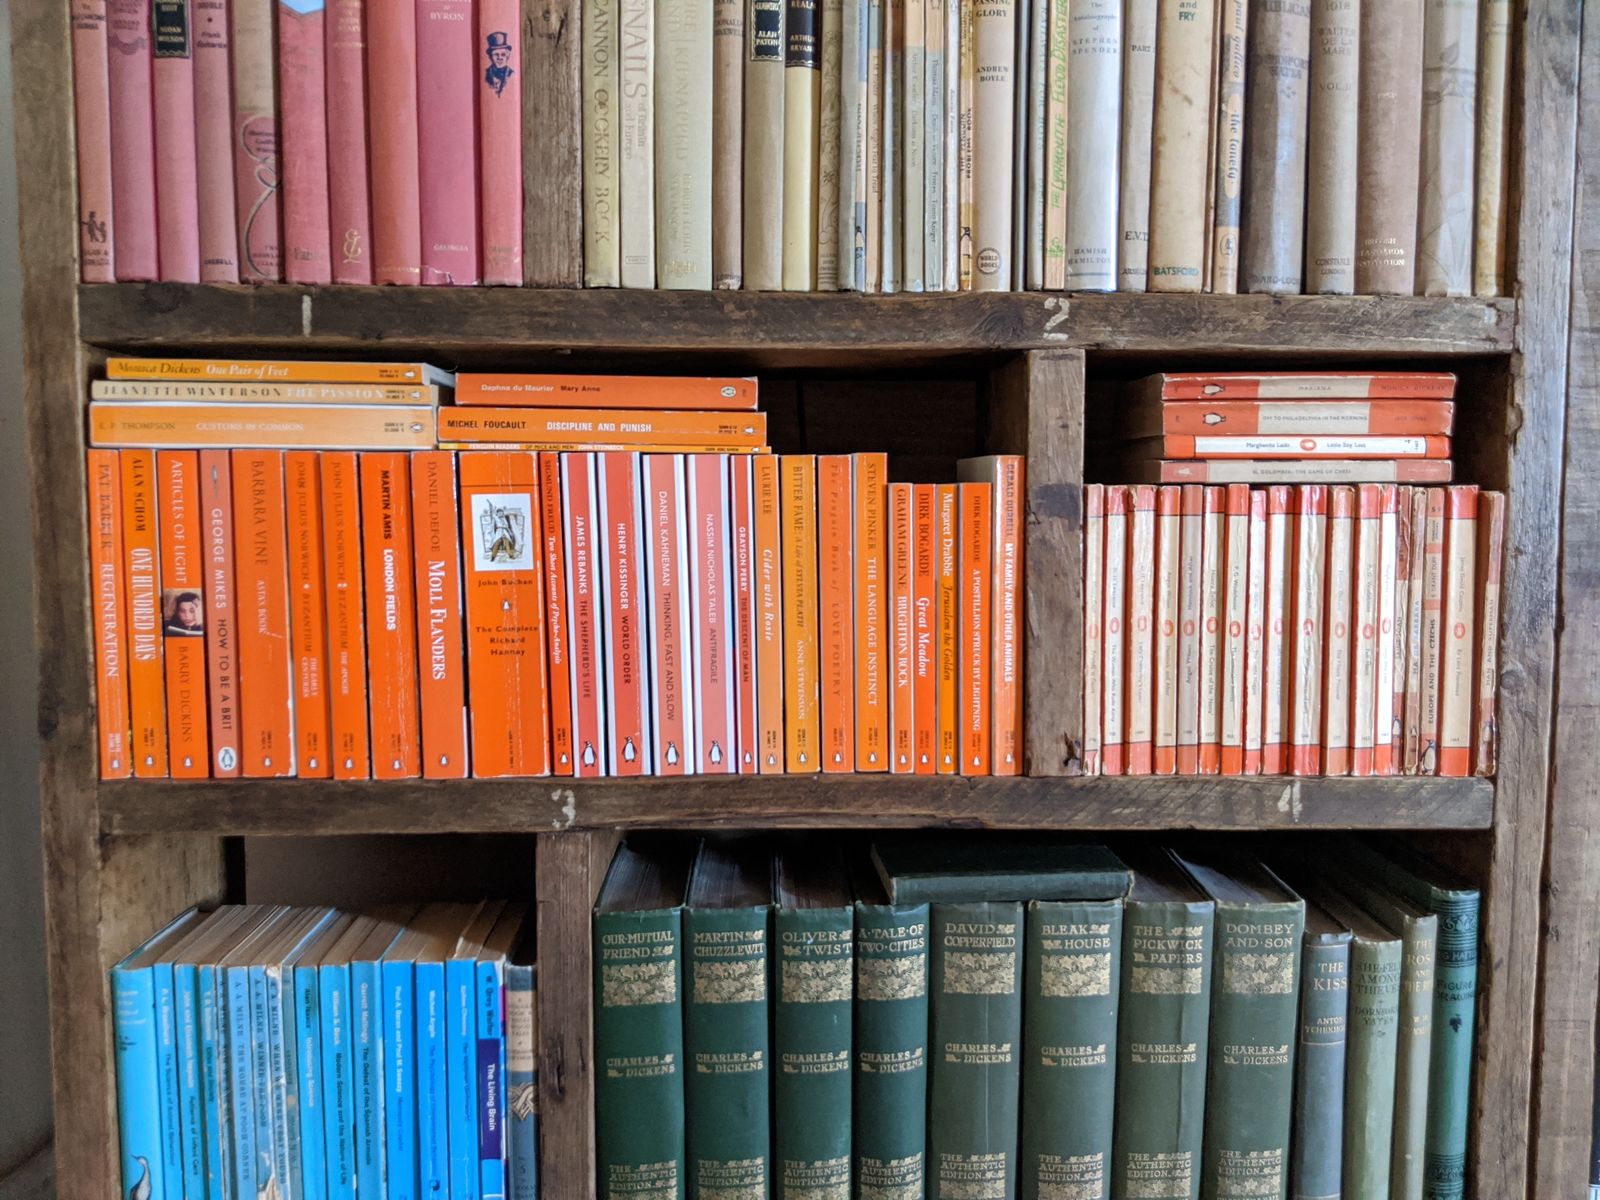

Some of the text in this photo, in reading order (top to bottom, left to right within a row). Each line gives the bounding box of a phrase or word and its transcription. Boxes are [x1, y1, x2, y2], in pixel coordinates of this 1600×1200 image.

[430, 11, 465, 22] BYRON
[976, 9, 1008, 18] GLORY
[1179, 12, 1195, 21] FRY
[757, 30, 778, 38] ALAN
[756, 38, 780, 46] PATON
[1227, 138, 1240, 180] lonely
[1153, 266, 1199, 277] BATSFORD
[1042, 297, 1070, 341] 2
[229, 365, 253, 376] Pair
[255, 365, 265, 378] of
[266, 366, 289, 377] Feet
[187, 387, 282, 397] WINTERSON
[321, 388, 384, 398] PASSION
[481, 384, 510, 394] Daphne
[512, 384, 522, 392] du
[525, 384, 554, 392] Maurier
[560, 385, 579, 394] Mary
[447, 420, 652, 433] MICHEL FOUCAULT DISCIPLINE AND PUNISH
[381, 470, 396, 630] MARTIN AMIS LONDON FIELDS
[738, 526, 748, 565] GRAYSON
[131, 457, 156, 660] ALAN SCHOM ONE HUNDRED DAYS
[761, 466, 775, 641] LAURIE LEE Cider with Rosie
[427, 461, 448, 680] DANIEL DEFOE MOLL FLANDERS
[739, 567, 749, 592] PERRY
[867, 463, 878, 706] STEVEN PINKER THE LANGUAGE INSTINCT
[917, 492, 930, 677] DIRK BOGARDE Great Meadow
[896, 488, 908, 687] GRAHAM GREENE BRIGHTON ROCK
[941, 492, 954, 681] Margaret Drabble Jerusalem the Golden
[171, 460, 192, 742] ARTICLES OF LIGHT BARRY DICKINS
[617, 523, 632, 684] HENRY KISSINGER WORLD ORDER
[705, 513, 719, 684] NASSIM NICHOLAS TALEB ANTIFRAGILE
[575, 515, 592, 698] JAMES REBANKS THE SHEPHERD'S LIFE
[658, 491, 675, 721] DANIEL KAHNEMAN THINKING, FAST AND SLOW
[1003, 543, 1014, 682] MY FAMILY AND OTHER ANIMALS
[102, 563, 118, 677] REGENERATION
[211, 508, 232, 730] GEORGE MIKES HOW TO BE A BRIT
[741, 649, 750, 661] OF
[742, 663, 750, 682] MAN
[551, 788, 576, 828] 3
[944, 923, 996, 934] DAVID
[1041, 925, 1088, 936] BLEAK
[1134, 925, 1164, 936] THE
[1226, 924, 1294, 935] DOMBEY
[694, 931, 746, 943] MARTIN
[782, 931, 837, 944] OLIVER
[944, 936, 1016, 948] COPPERFIELD
[1064, 937, 1111, 949] HOUSE
[694, 943, 765, 956] CHUZZLEWIT
[803, 943, 853, 956] TWIST
[1133, 938, 1202, 950] PICKWICK
[603, 947, 650, 959] FRIEND
[1150, 953, 1202, 964] PAPERS
[1318, 962, 1344, 973] THE
[1312, 978, 1347, 991] KISS
[945, 1043, 996, 1053] CHARLES
[963, 1053, 1012, 1063] DICKENS
[486, 1064, 496, 1130] The Living Brain
[940, 1160, 1006, 1170] AUTHENTIC
